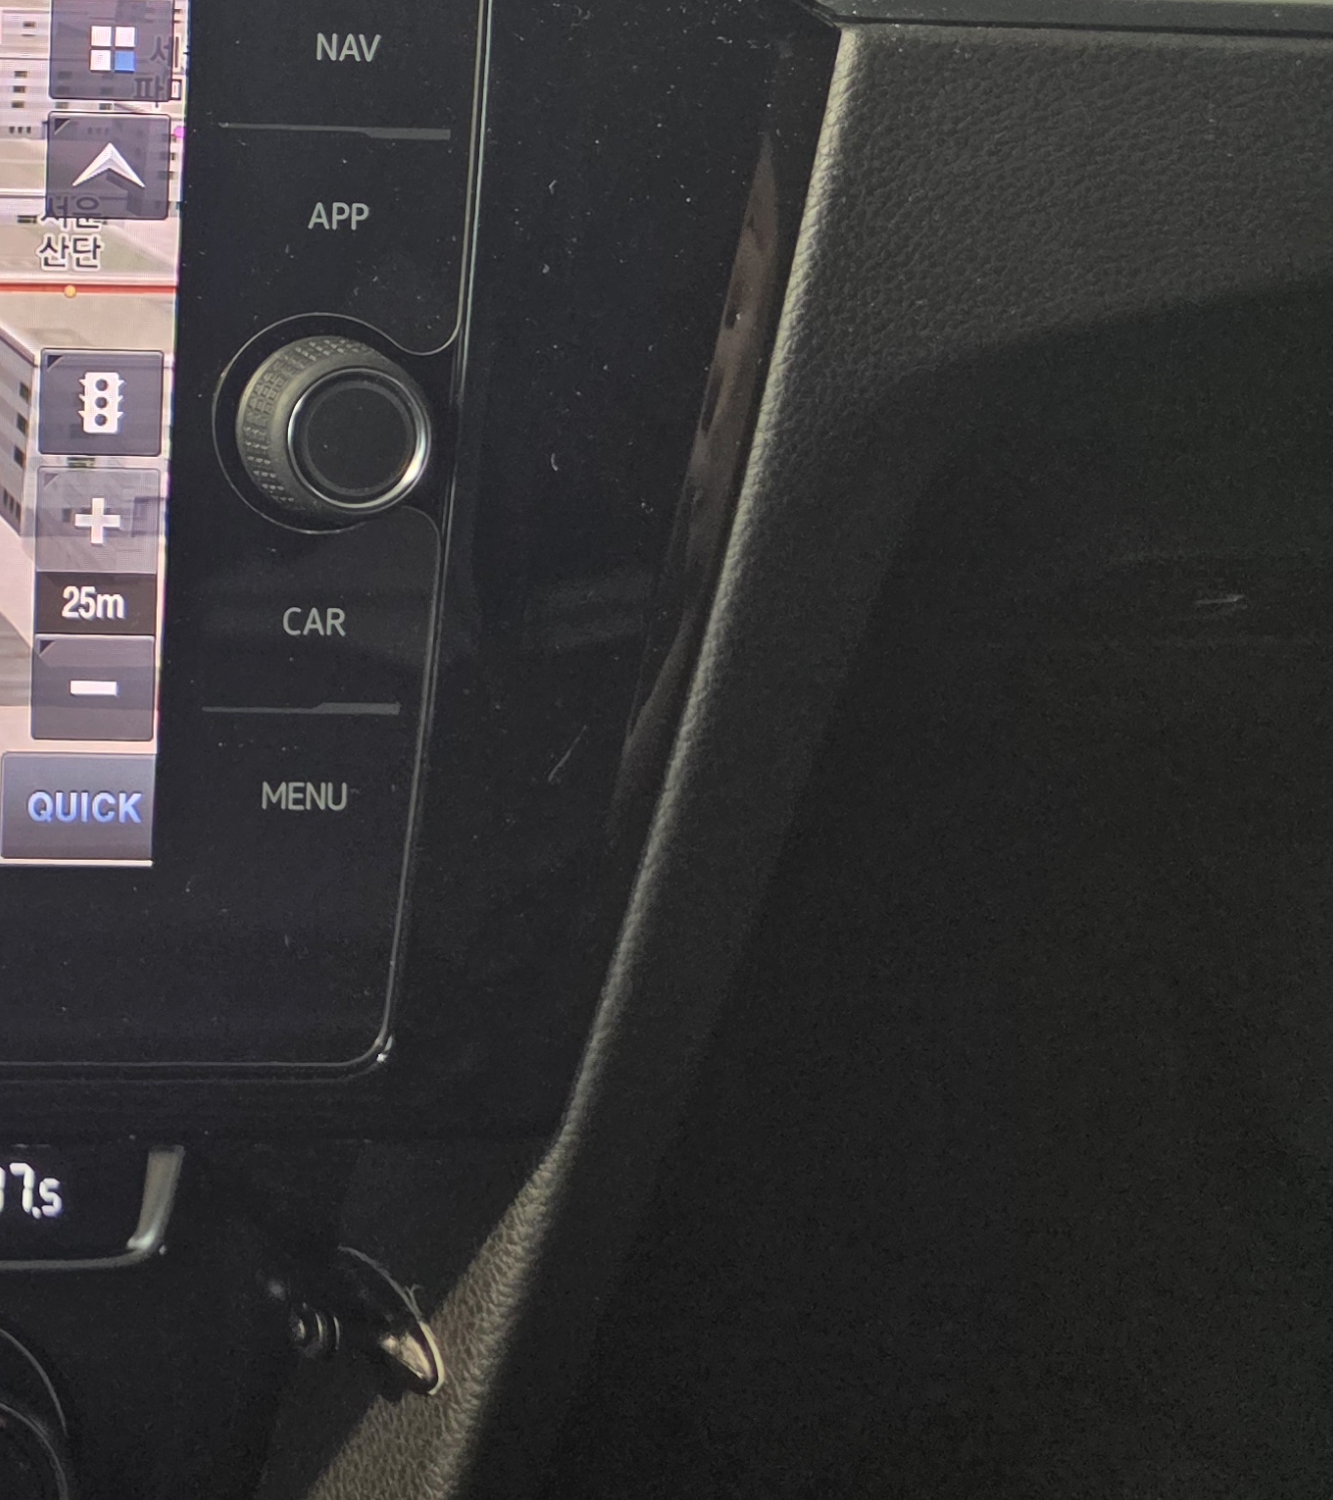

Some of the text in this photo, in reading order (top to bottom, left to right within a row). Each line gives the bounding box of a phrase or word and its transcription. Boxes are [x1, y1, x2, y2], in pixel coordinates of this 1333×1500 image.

[315, 33, 382, 64] NAV
[308, 201, 370, 232] APP
[40, 237, 102, 268] 산단
[61, 585, 126, 620] 25m
[281, 607, 347, 638] CAR
[27, 790, 143, 825] QUICK
[261, 781, 348, 813] MENU
